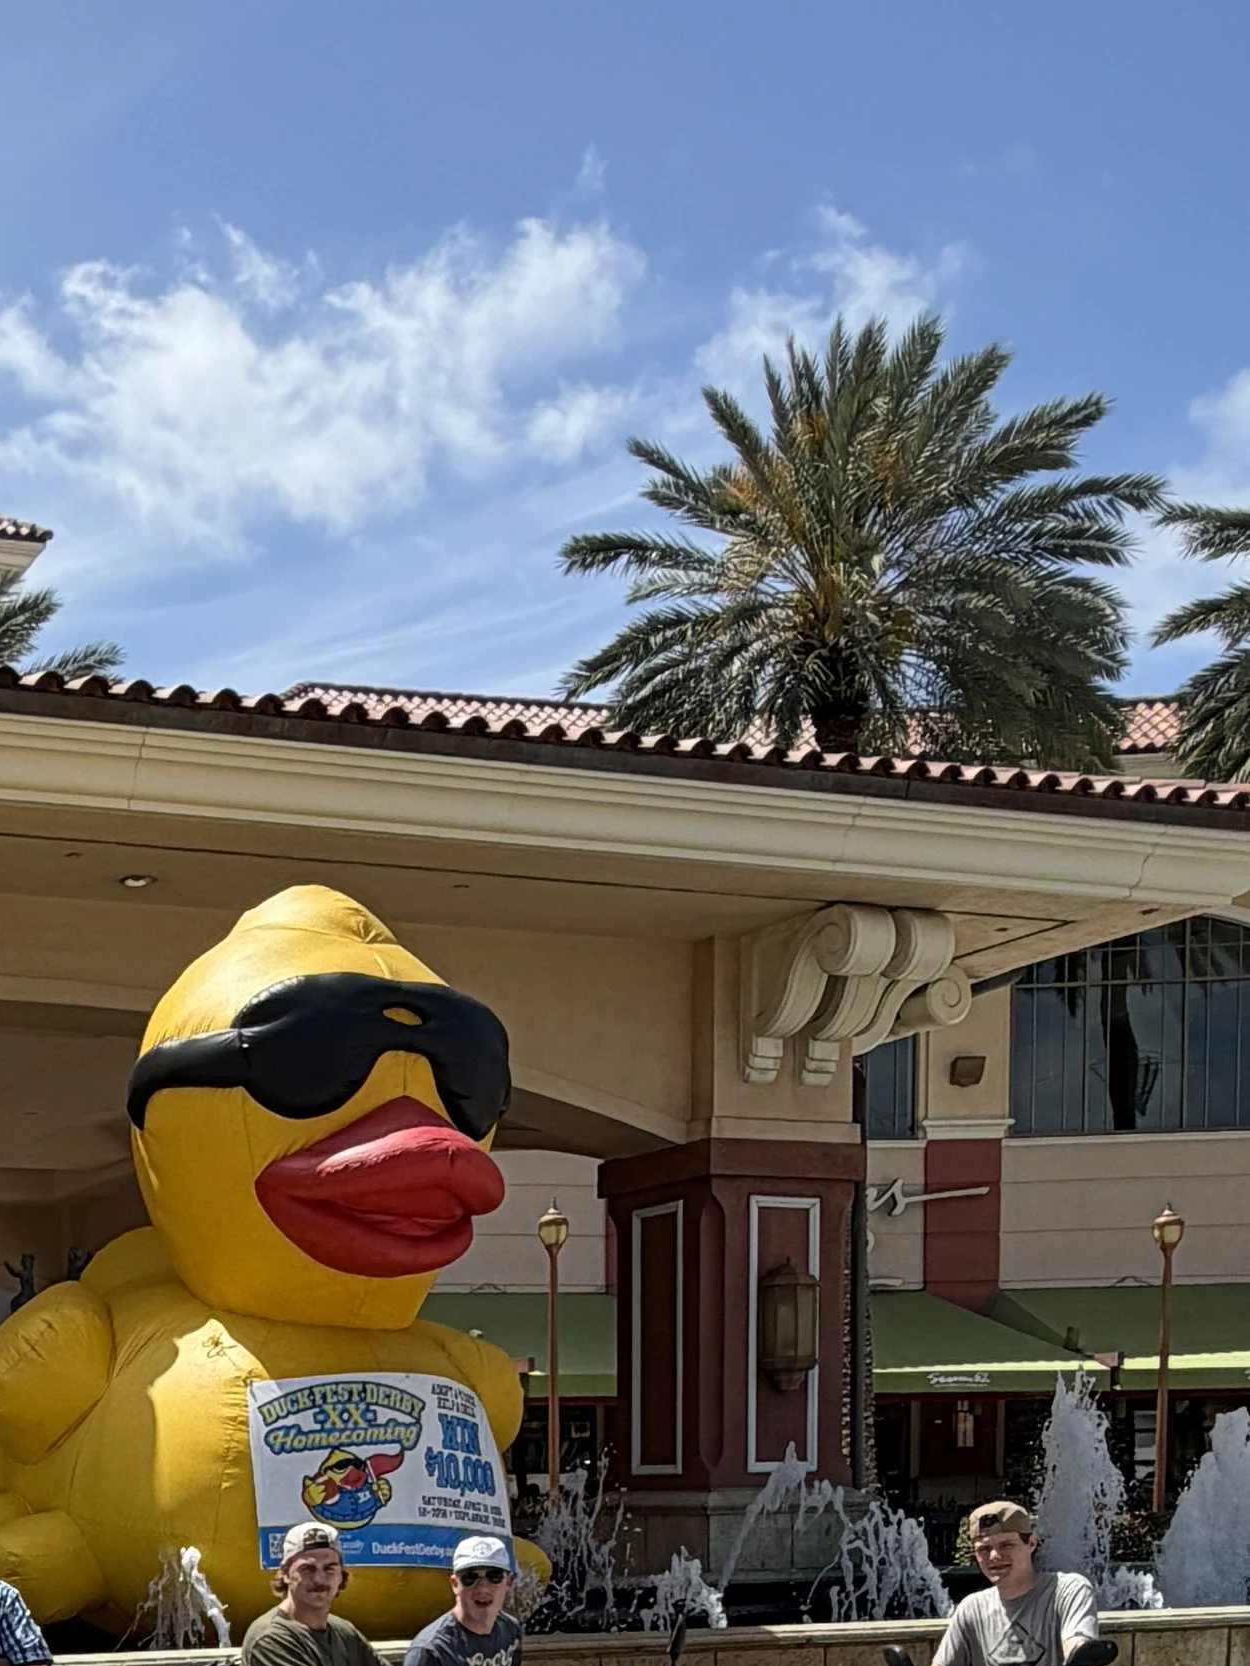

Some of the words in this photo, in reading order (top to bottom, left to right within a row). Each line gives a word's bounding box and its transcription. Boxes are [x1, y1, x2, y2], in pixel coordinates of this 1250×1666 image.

[259, 1388, 311, 1424] DUCK
[312, 1382, 363, 1405] FEST
[364, 1382, 425, 1422] DERBY
[268, 1419, 421, 1453] Homecoming
[438, 1412, 482, 1457] WIN
[424, 1446, 496, 1497] $10,000
